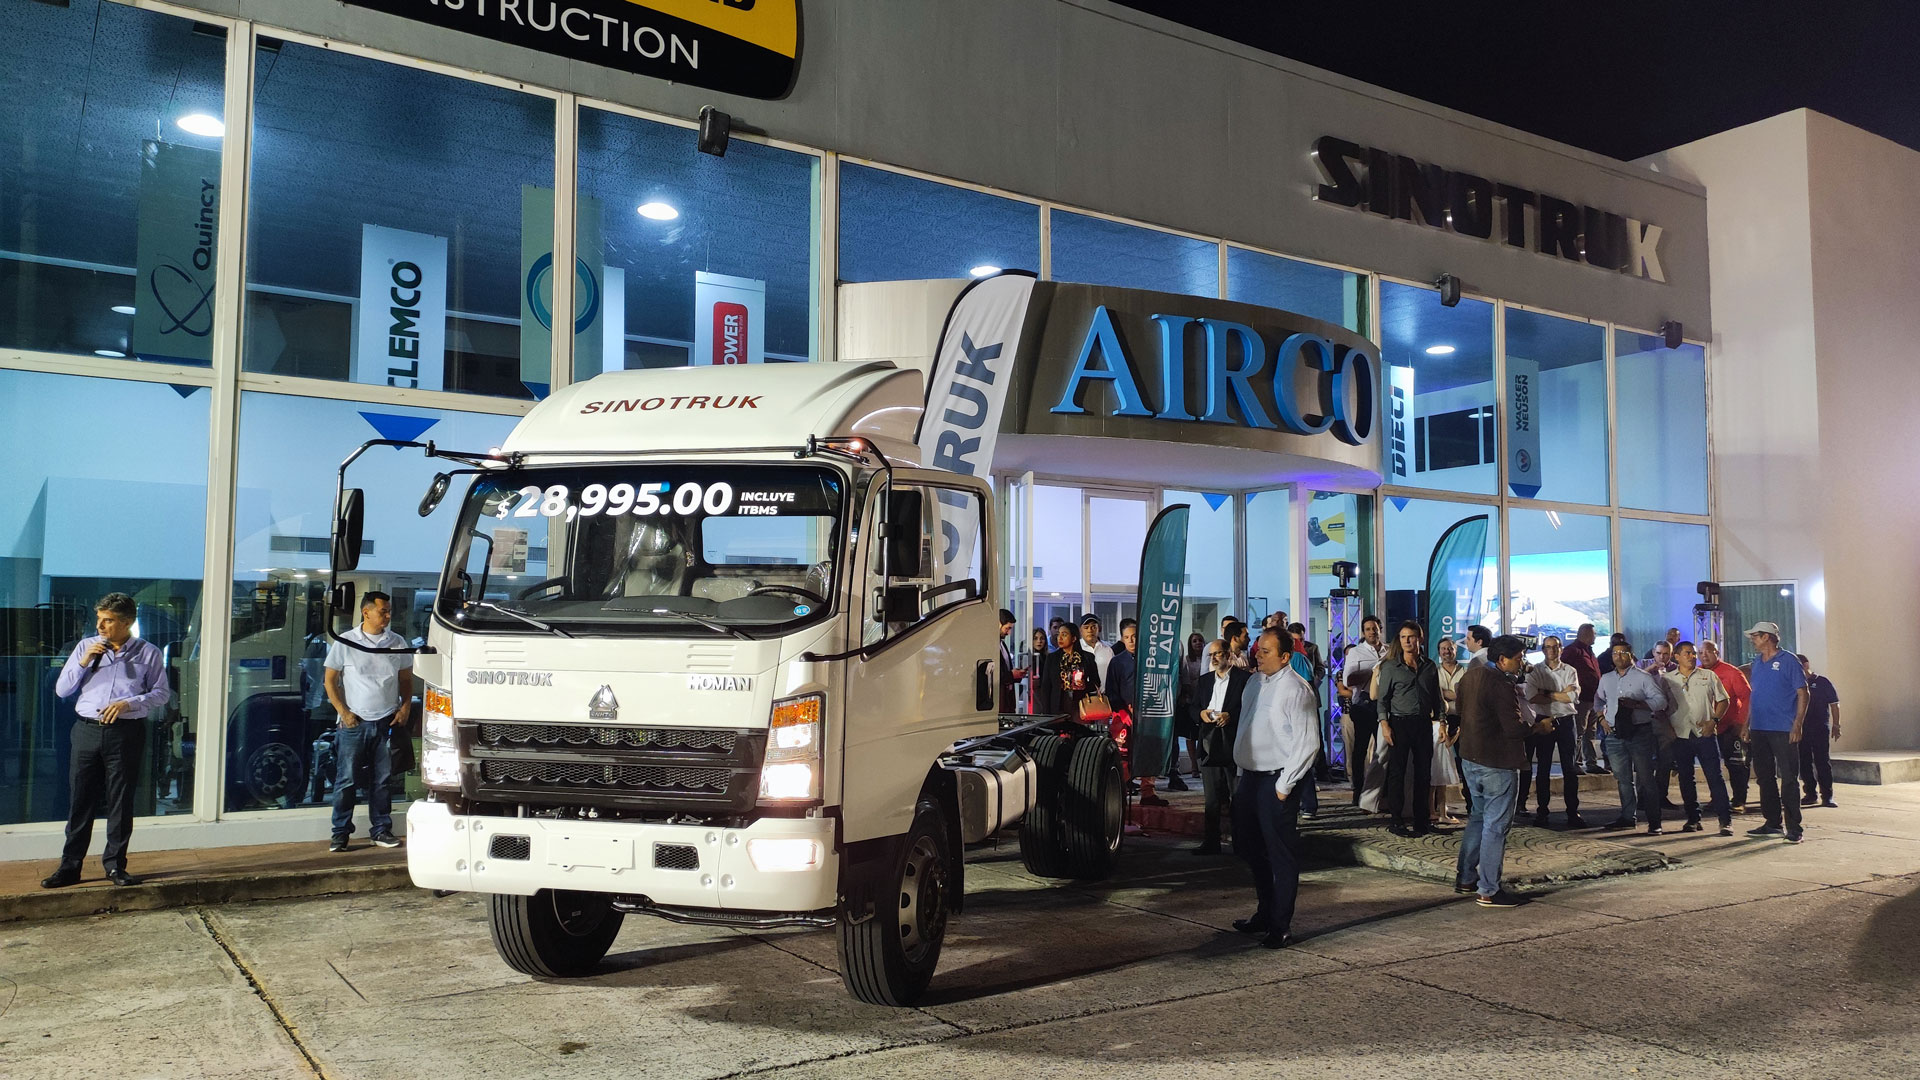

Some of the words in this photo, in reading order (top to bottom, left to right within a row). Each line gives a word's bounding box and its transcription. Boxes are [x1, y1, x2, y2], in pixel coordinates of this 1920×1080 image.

[1310, 135, 1666, 283] SINOTRUK
[1050, 305, 1377, 446] AIRCO
[1515, 374, 1523, 432] WACKER
[580, 396, 765, 414] SINOTRUK
[1521, 375, 1529, 432] NEUSON
[496, 481, 733, 523] $28,995.00
[738, 505, 778, 515] ITBMS
[740, 492, 796, 502] INCLUYE
[1145, 613, 1159, 668] Banco
[1158, 581, 1181, 670] LAFISE
[466, 670, 553, 687] SINOTRUK
